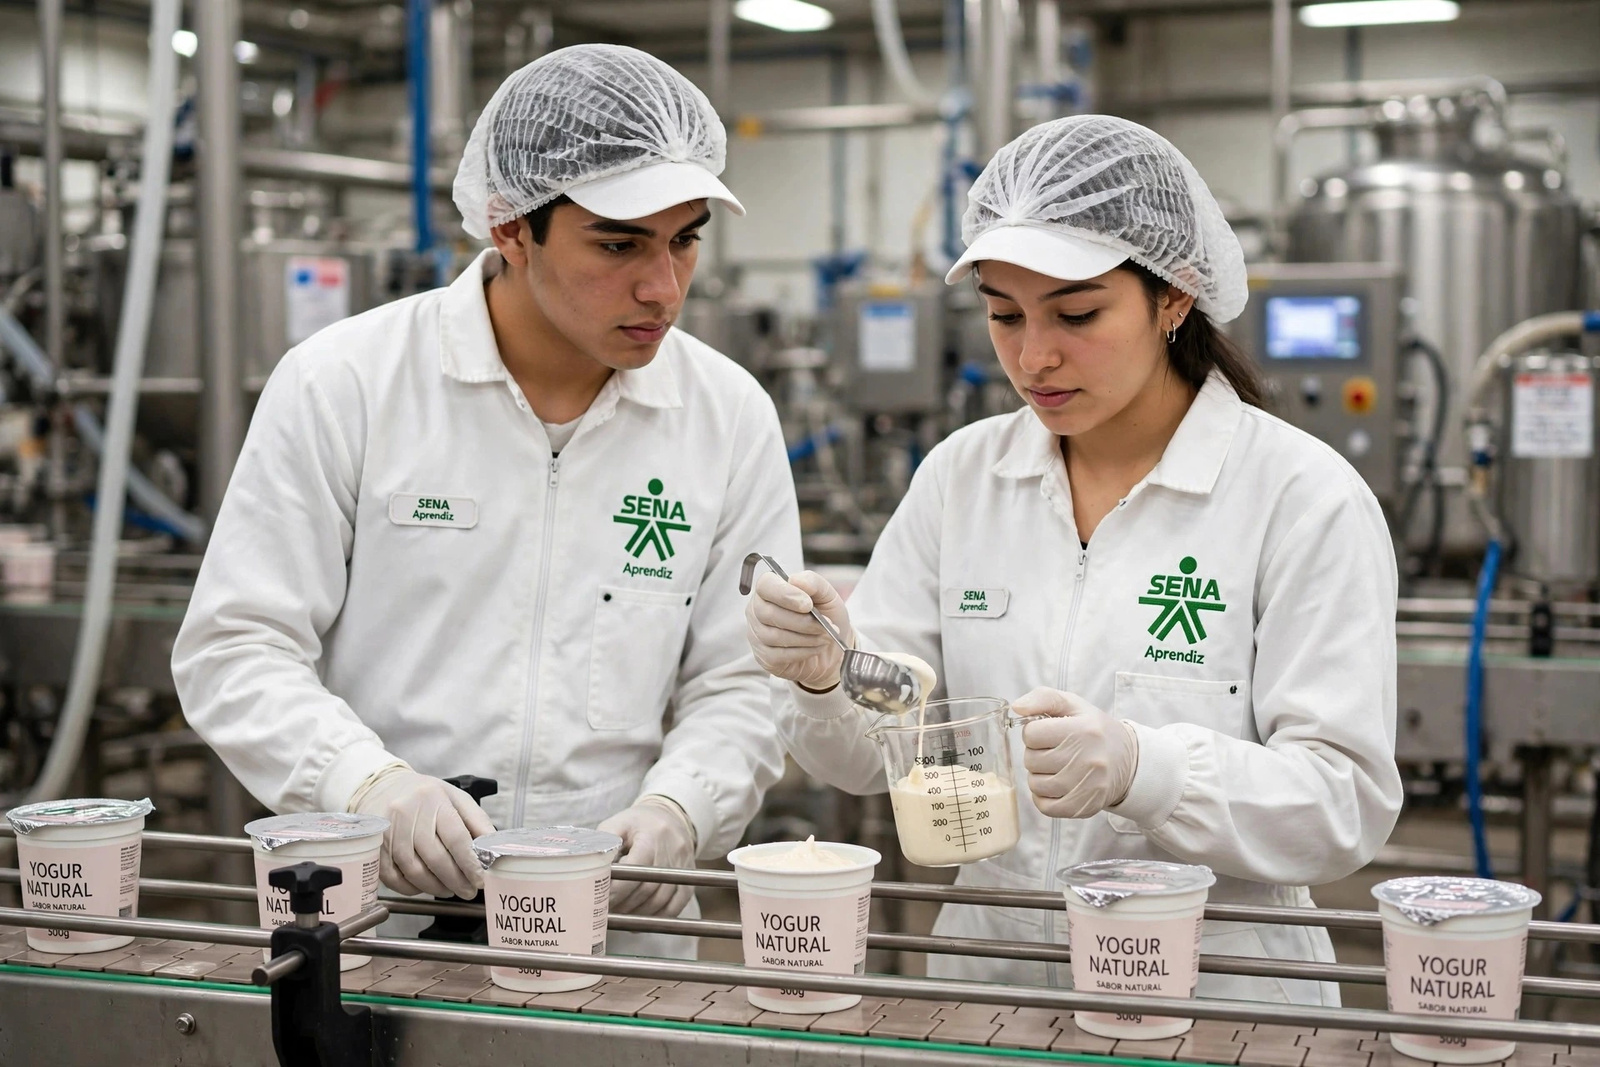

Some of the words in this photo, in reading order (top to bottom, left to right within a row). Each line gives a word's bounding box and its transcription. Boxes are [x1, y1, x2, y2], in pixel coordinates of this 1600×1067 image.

[418, 498, 450, 510] SENA
[621, 495, 686, 521] SENA
[412, 510, 454, 521] Aprendiz
[623, 562, 673, 579] Aprendiz
[963, 591, 986, 600] SENA
[1147, 575, 1221, 601] SENA
[959, 602, 988, 613] Aprendiz
[1144, 645, 1205, 664] Aprendiz
[967, 746, 984, 756] 100
[924, 771, 939, 779] 500
[931, 802, 944, 810] 100
[976, 810, 990, 820] 200
[979, 826, 992, 836] 100
[29, 860, 83, 879] YOGUR
[26, 879, 93, 898] NATURAL
[32, 901, 52, 910] SABOR
[53, 903, 86, 911] NATURAL
[266, 896, 335, 915] NATL
[498, 893, 556, 913] YOGUR
[495, 913, 566, 933] NATURAL
[760, 912, 821, 932] YOGUR
[501, 936, 523, 946] SABOR
[524, 939, 559, 947] NATURAL
[756, 932, 831, 953] NATURAL
[1096, 934, 1161, 955] YOGUR
[762, 956, 786, 966] SABOR
[787, 959, 824, 967] NATURAL
[1089, 955, 1170, 977] NATURAL
[1418, 954, 1487, 977] YOGUR
[1096, 980, 1122, 991] SABOR
[1125, 983, 1162, 991] NATURAL
[1410, 976, 1495, 999] NATURAL
[1418, 1002, 1446, 1012] SABOR
[1449, 1005, 1487, 1014] NATURAL
